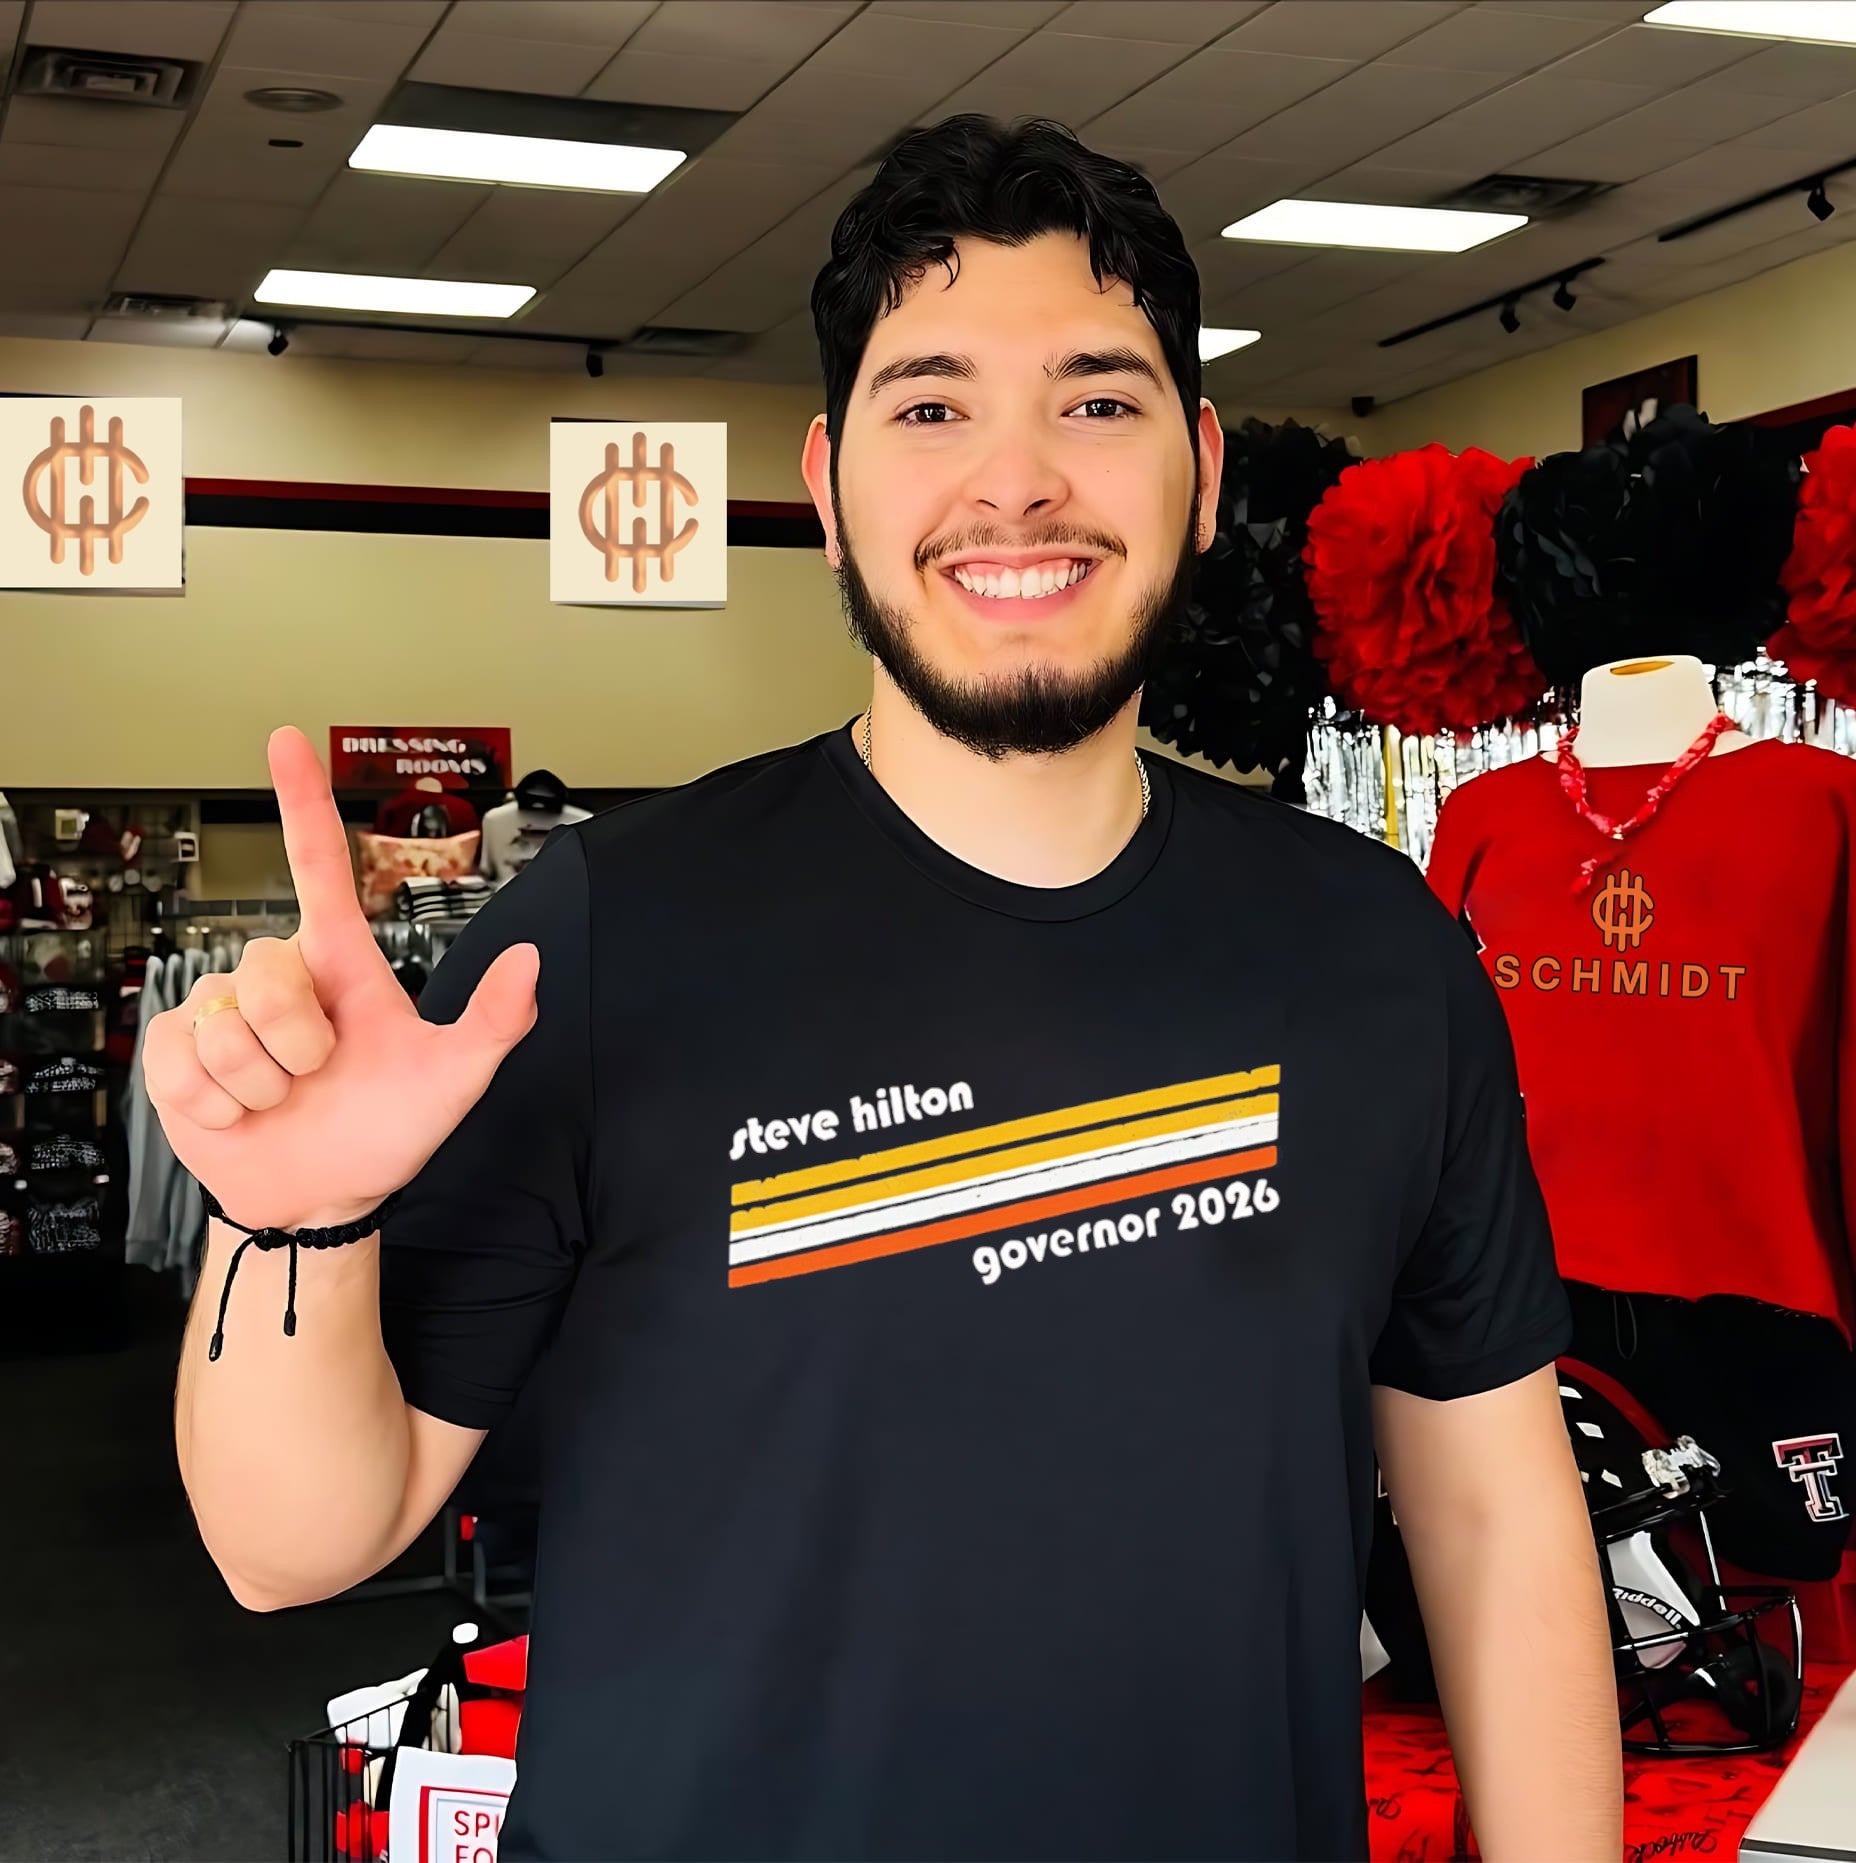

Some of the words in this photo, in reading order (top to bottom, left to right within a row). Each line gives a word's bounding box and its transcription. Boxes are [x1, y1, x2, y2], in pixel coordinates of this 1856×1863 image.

[342, 737, 467, 754] DRESSING
[396, 758, 487, 775] ROOMS
[1494, 954, 1747, 1000] SCHMIDT
[729, 1109, 840, 1161] steve
[849, 1081, 974, 1134] hilton
[972, 1207, 1161, 1285] governor
[1171, 1178, 1281, 1232] 2026
